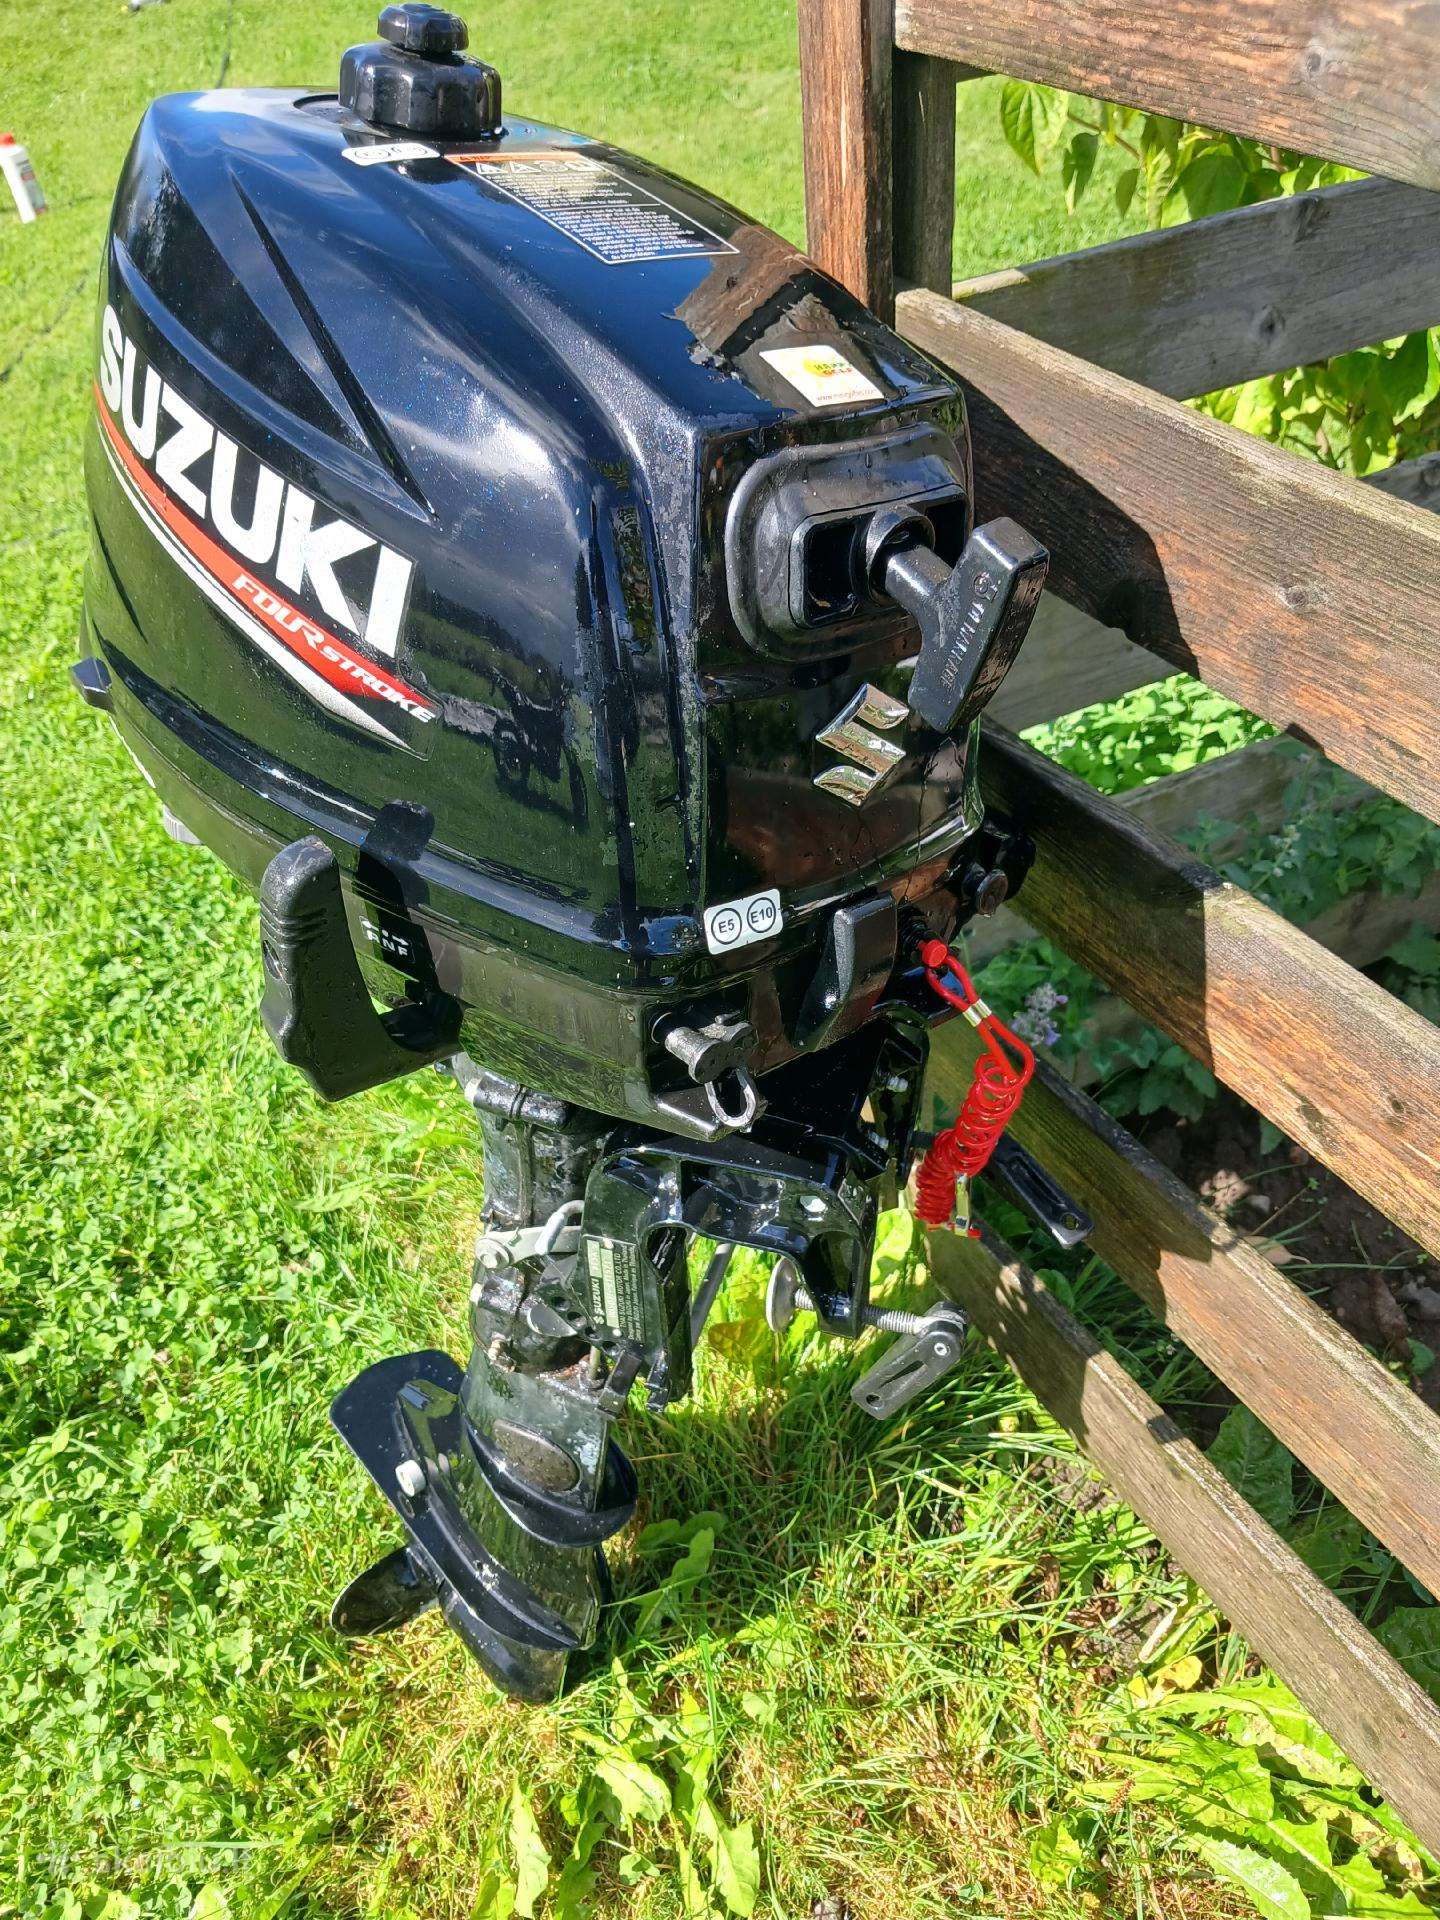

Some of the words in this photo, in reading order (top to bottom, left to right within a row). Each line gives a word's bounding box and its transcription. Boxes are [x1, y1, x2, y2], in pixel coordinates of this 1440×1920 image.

[100, 305, 413, 658] SUZUKI
[232, 575, 324, 650] FOUR
[320, 646, 436, 722] STROKE
[718, 918, 735, 934] E5
[751, 907, 773, 924] E10
[591, 1277, 604, 1315] SUZUKI
